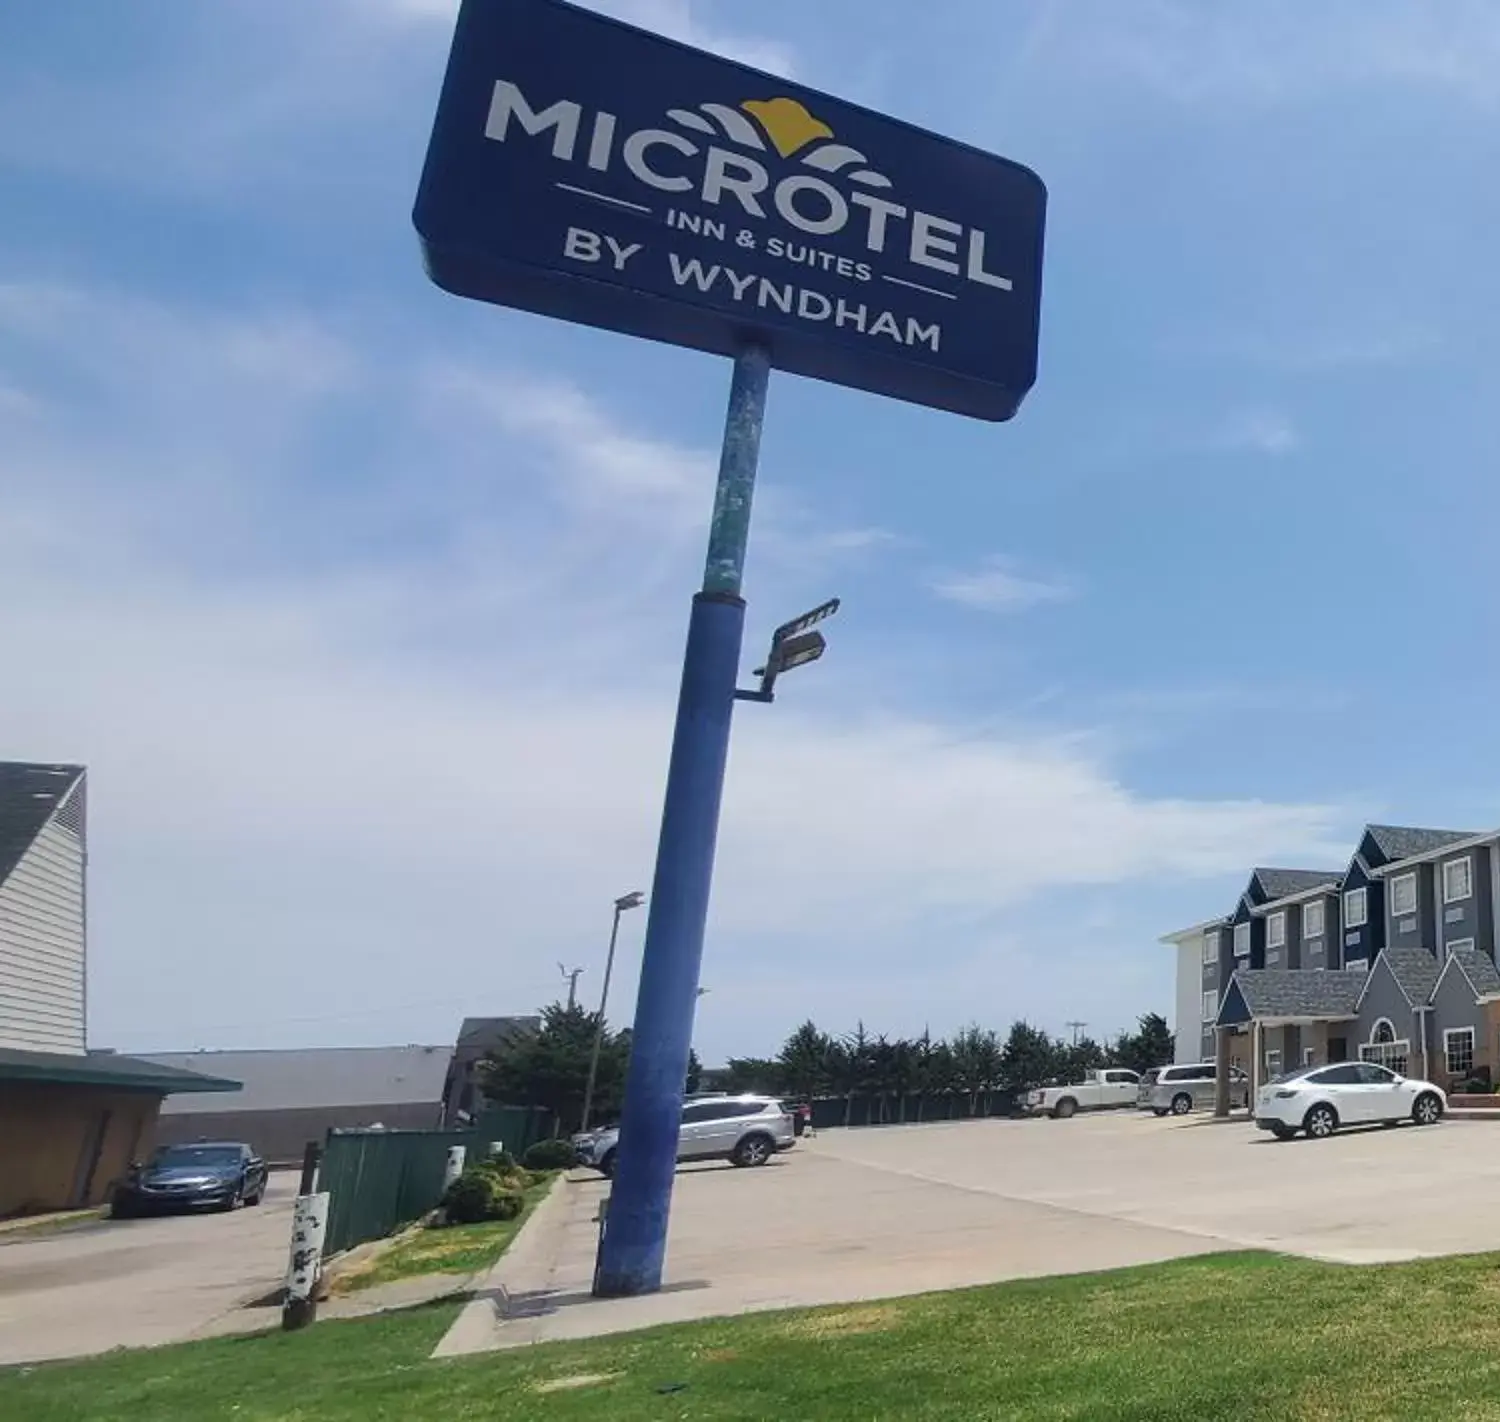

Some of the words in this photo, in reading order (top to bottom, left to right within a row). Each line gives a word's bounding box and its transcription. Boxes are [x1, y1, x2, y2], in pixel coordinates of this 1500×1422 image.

[484, 79, 1014, 291] MICROTEL
[667, 208, 726, 240] INN
[735, 228, 757, 249] &
[767, 238, 873, 282] SUITES
[564, 227, 643, 270] BY
[669, 253, 942, 353] WYNDHAM
